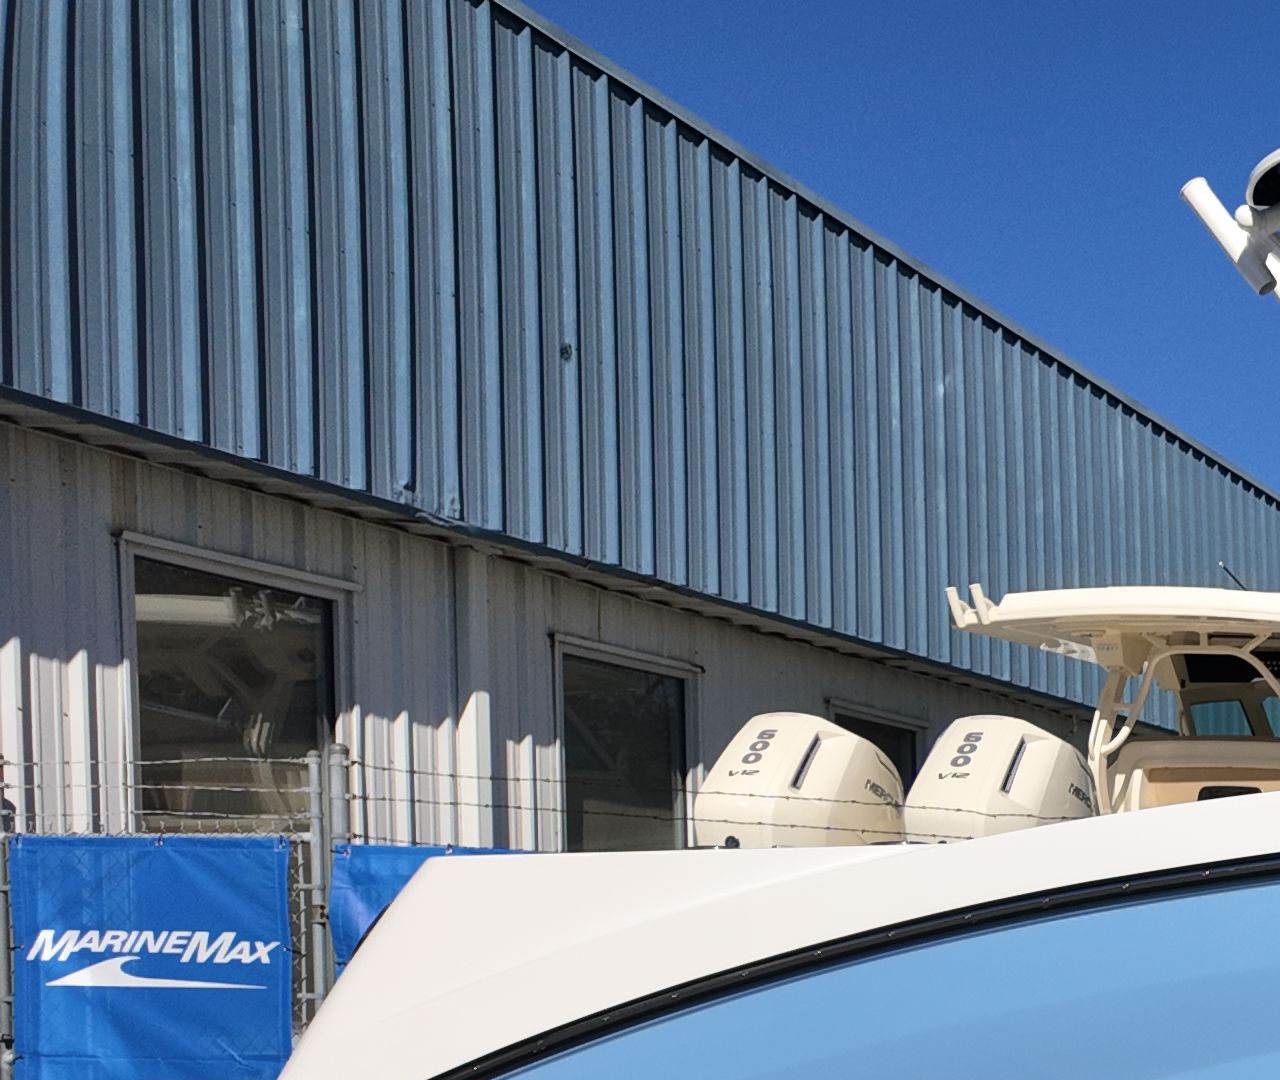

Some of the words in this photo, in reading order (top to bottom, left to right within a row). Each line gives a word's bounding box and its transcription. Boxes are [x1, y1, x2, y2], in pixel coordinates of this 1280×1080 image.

[741, 729, 778, 764] 600
[950, 732, 984, 767] 600
[26, 929, 281, 965] MARINEMAX
